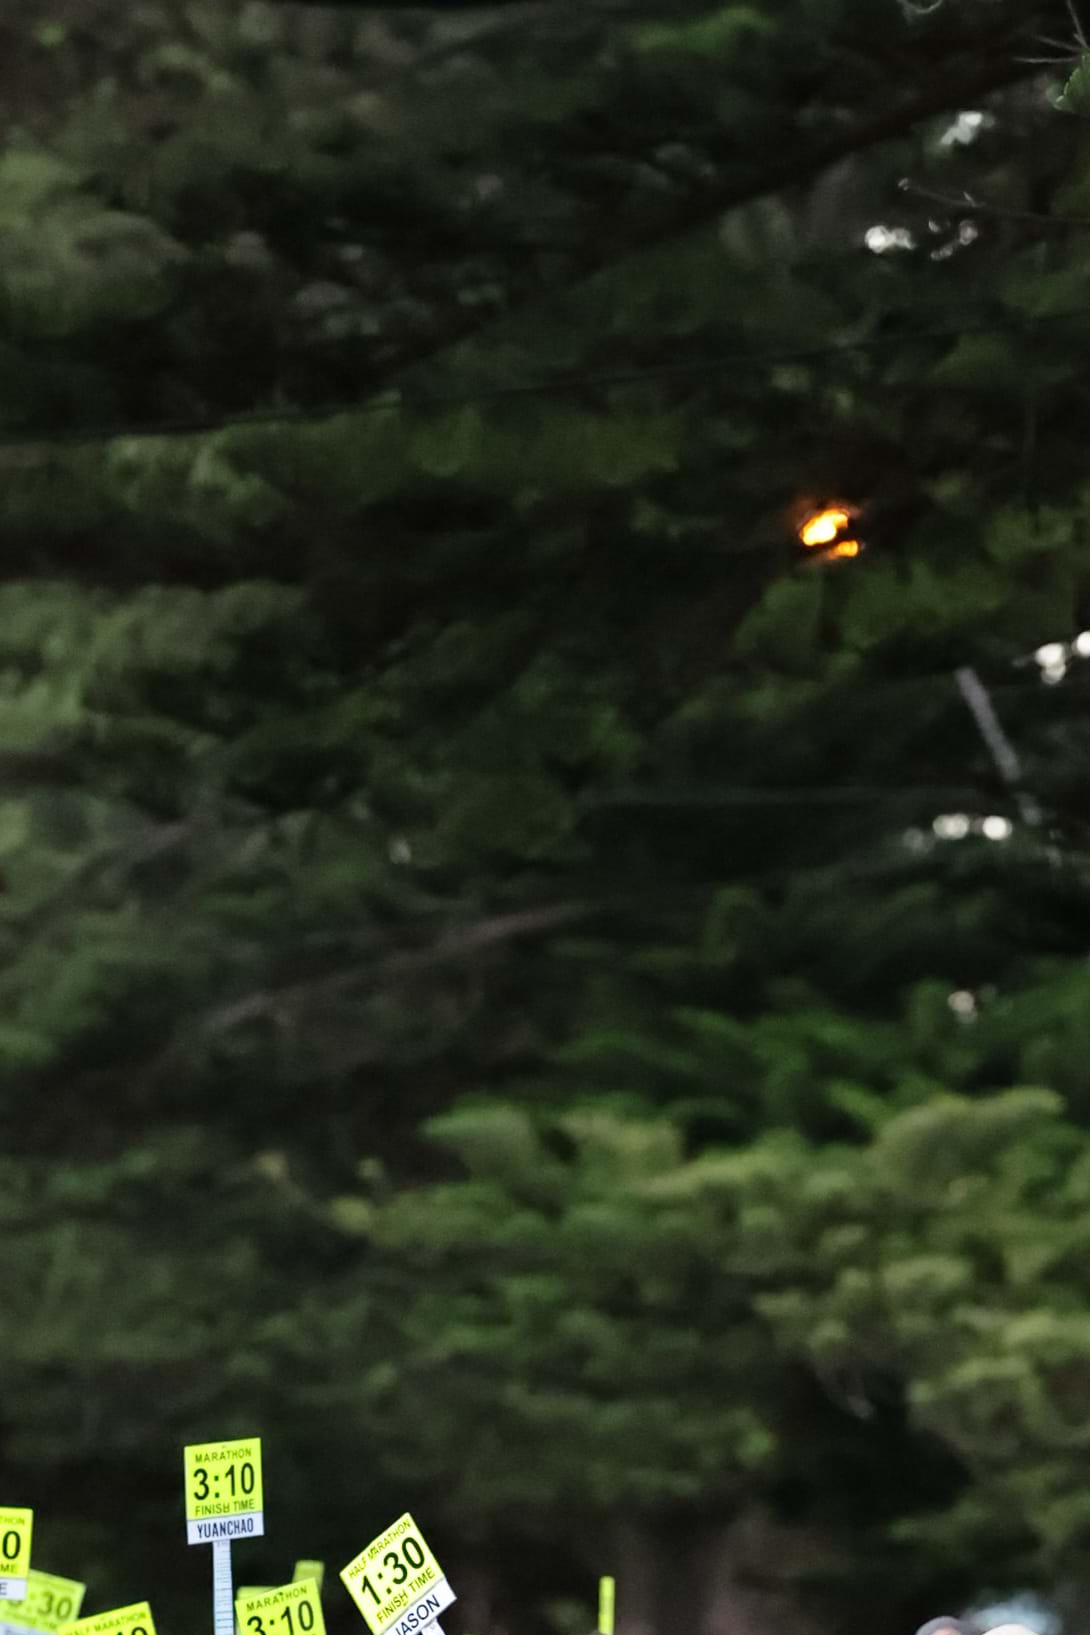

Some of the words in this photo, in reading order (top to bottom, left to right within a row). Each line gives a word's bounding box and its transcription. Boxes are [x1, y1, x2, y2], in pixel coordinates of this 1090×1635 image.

[195, 1447, 252, 1463] MARATHON
[193, 1462, 255, 1501] 3:10
[195, 1503, 230, 1517] FINISH
[233, 1498, 256, 1511] TIME
[197, 1517, 254, 1539] YUANCHAO
[348, 1556, 367, 1579] HALF
[367, 1518, 412, 1560] MARATHON
[361, 1536, 425, 1606] 1:30
[246, 1585, 308, 1612] MARATHON
[376, 1589, 409, 1624] FINISH
[408, 1565, 436, 1594] TIME
